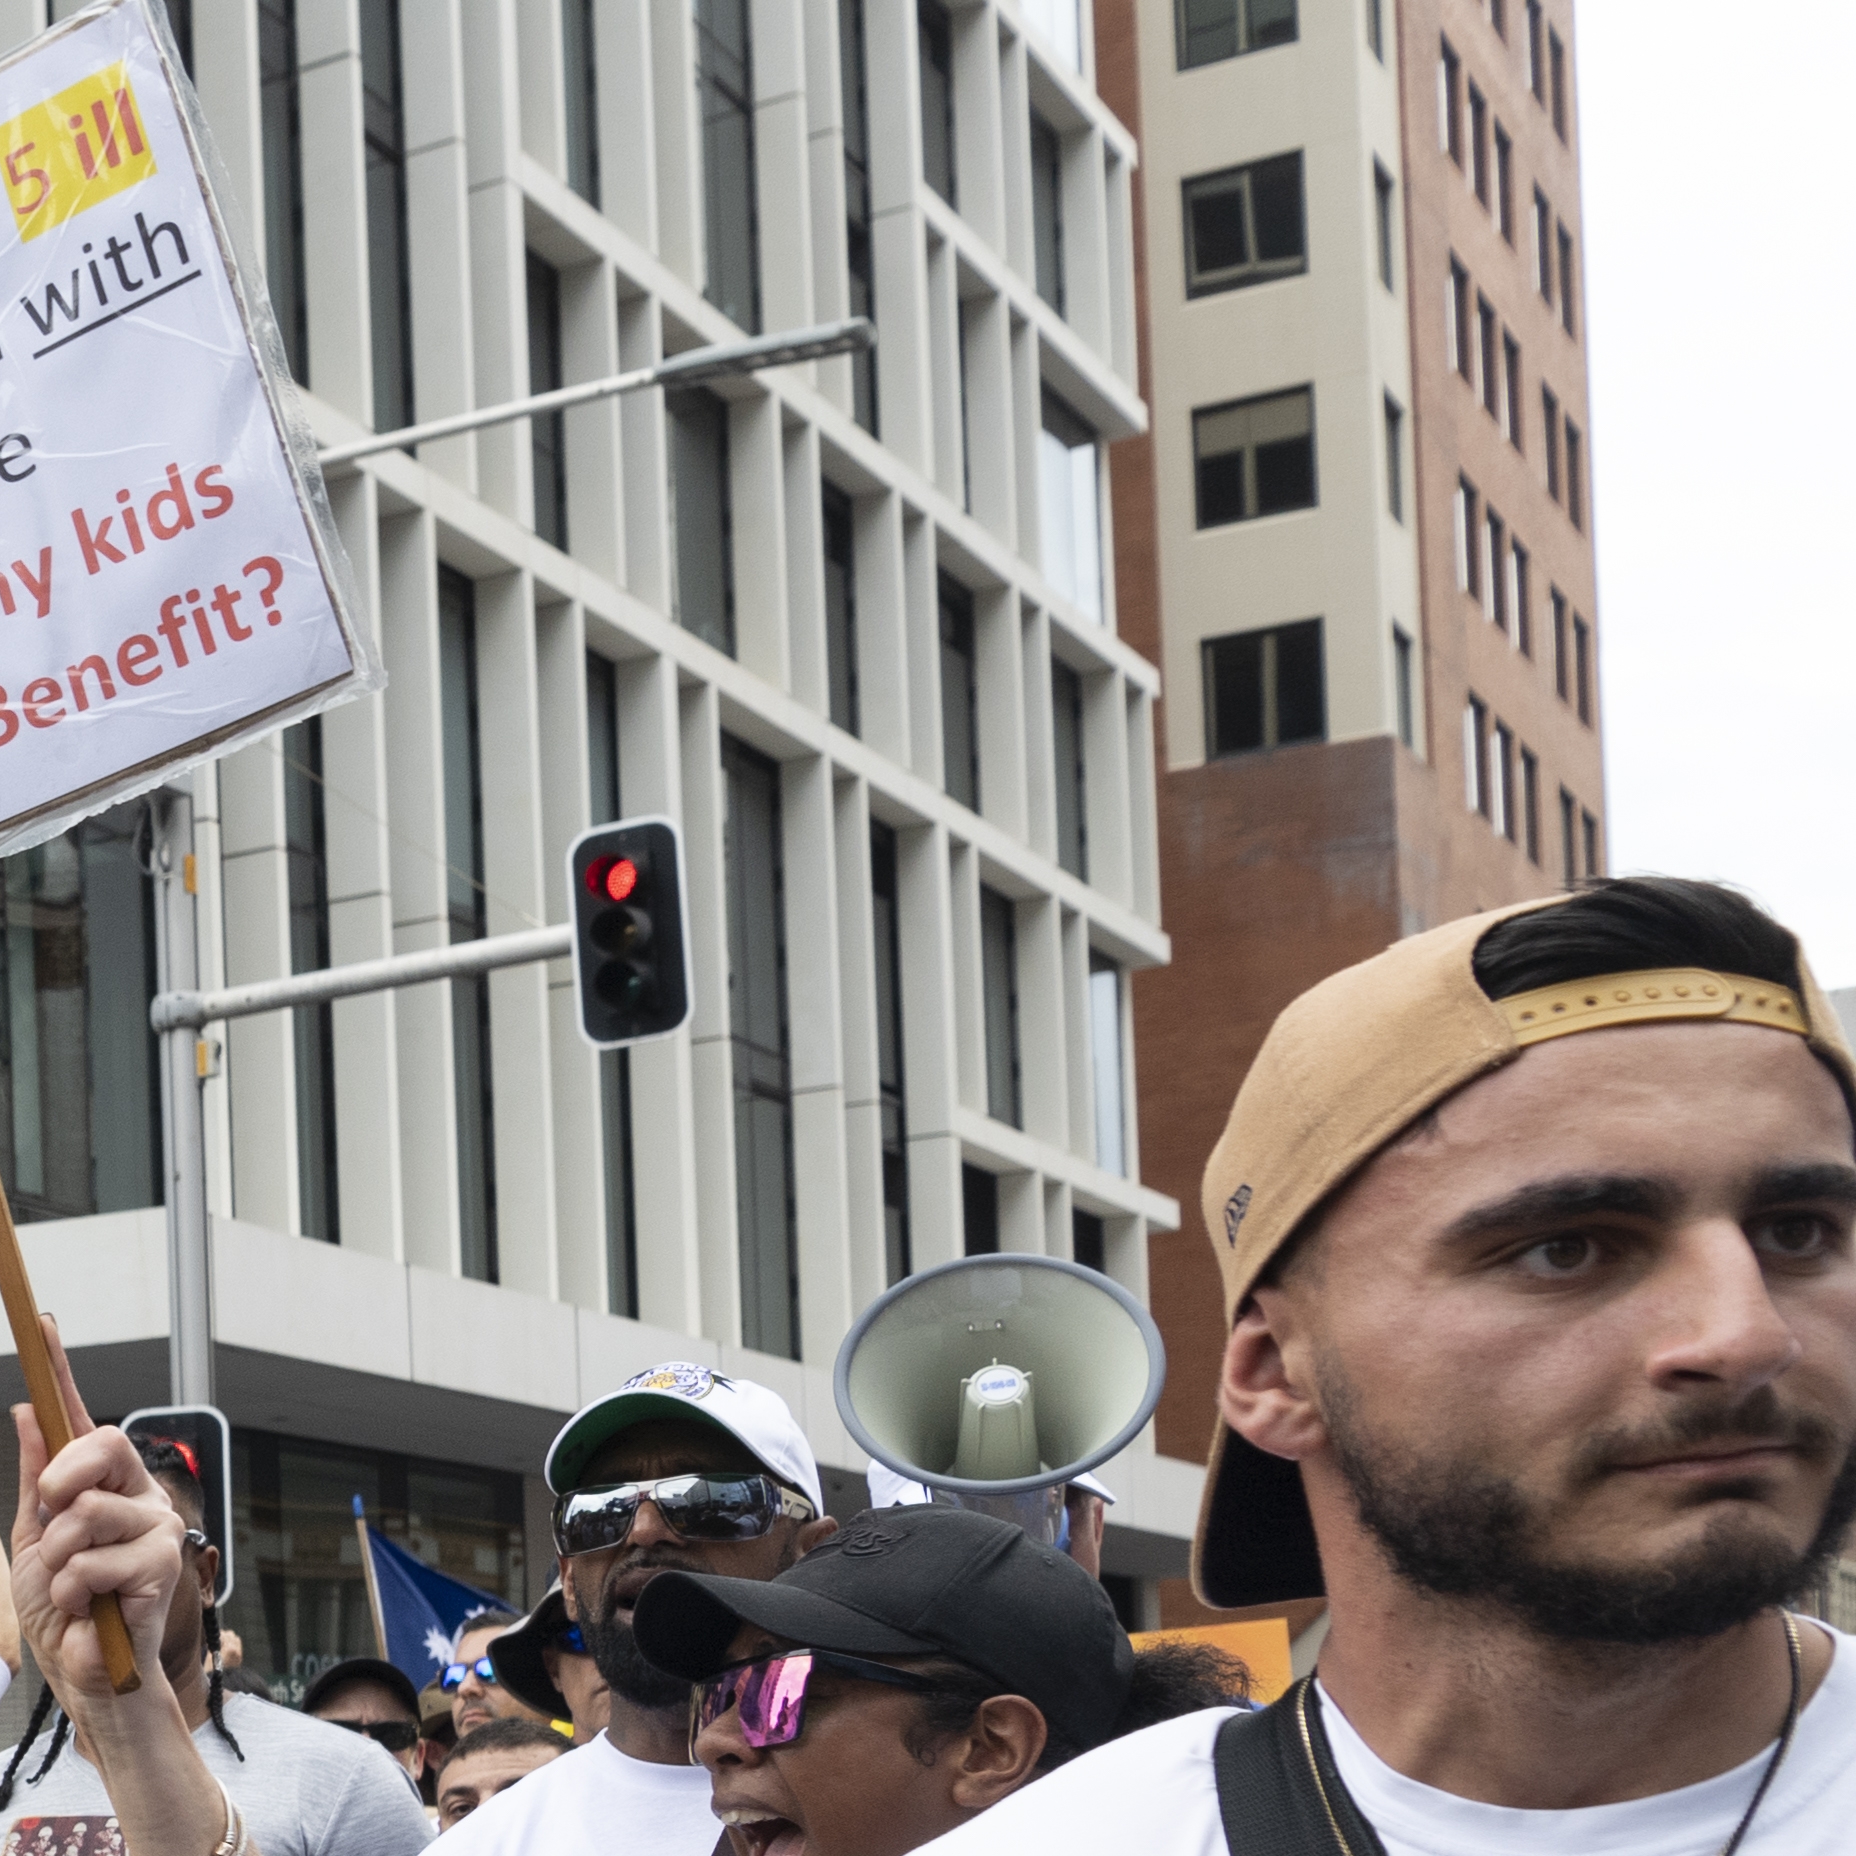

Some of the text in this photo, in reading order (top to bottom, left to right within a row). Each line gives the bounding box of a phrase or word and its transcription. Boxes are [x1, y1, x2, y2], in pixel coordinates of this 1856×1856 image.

[5, 142, 51, 217] 5
[77, 88, 146, 182] ill
[20, 213, 191, 337] with
[70, 464, 236, 576] kids
